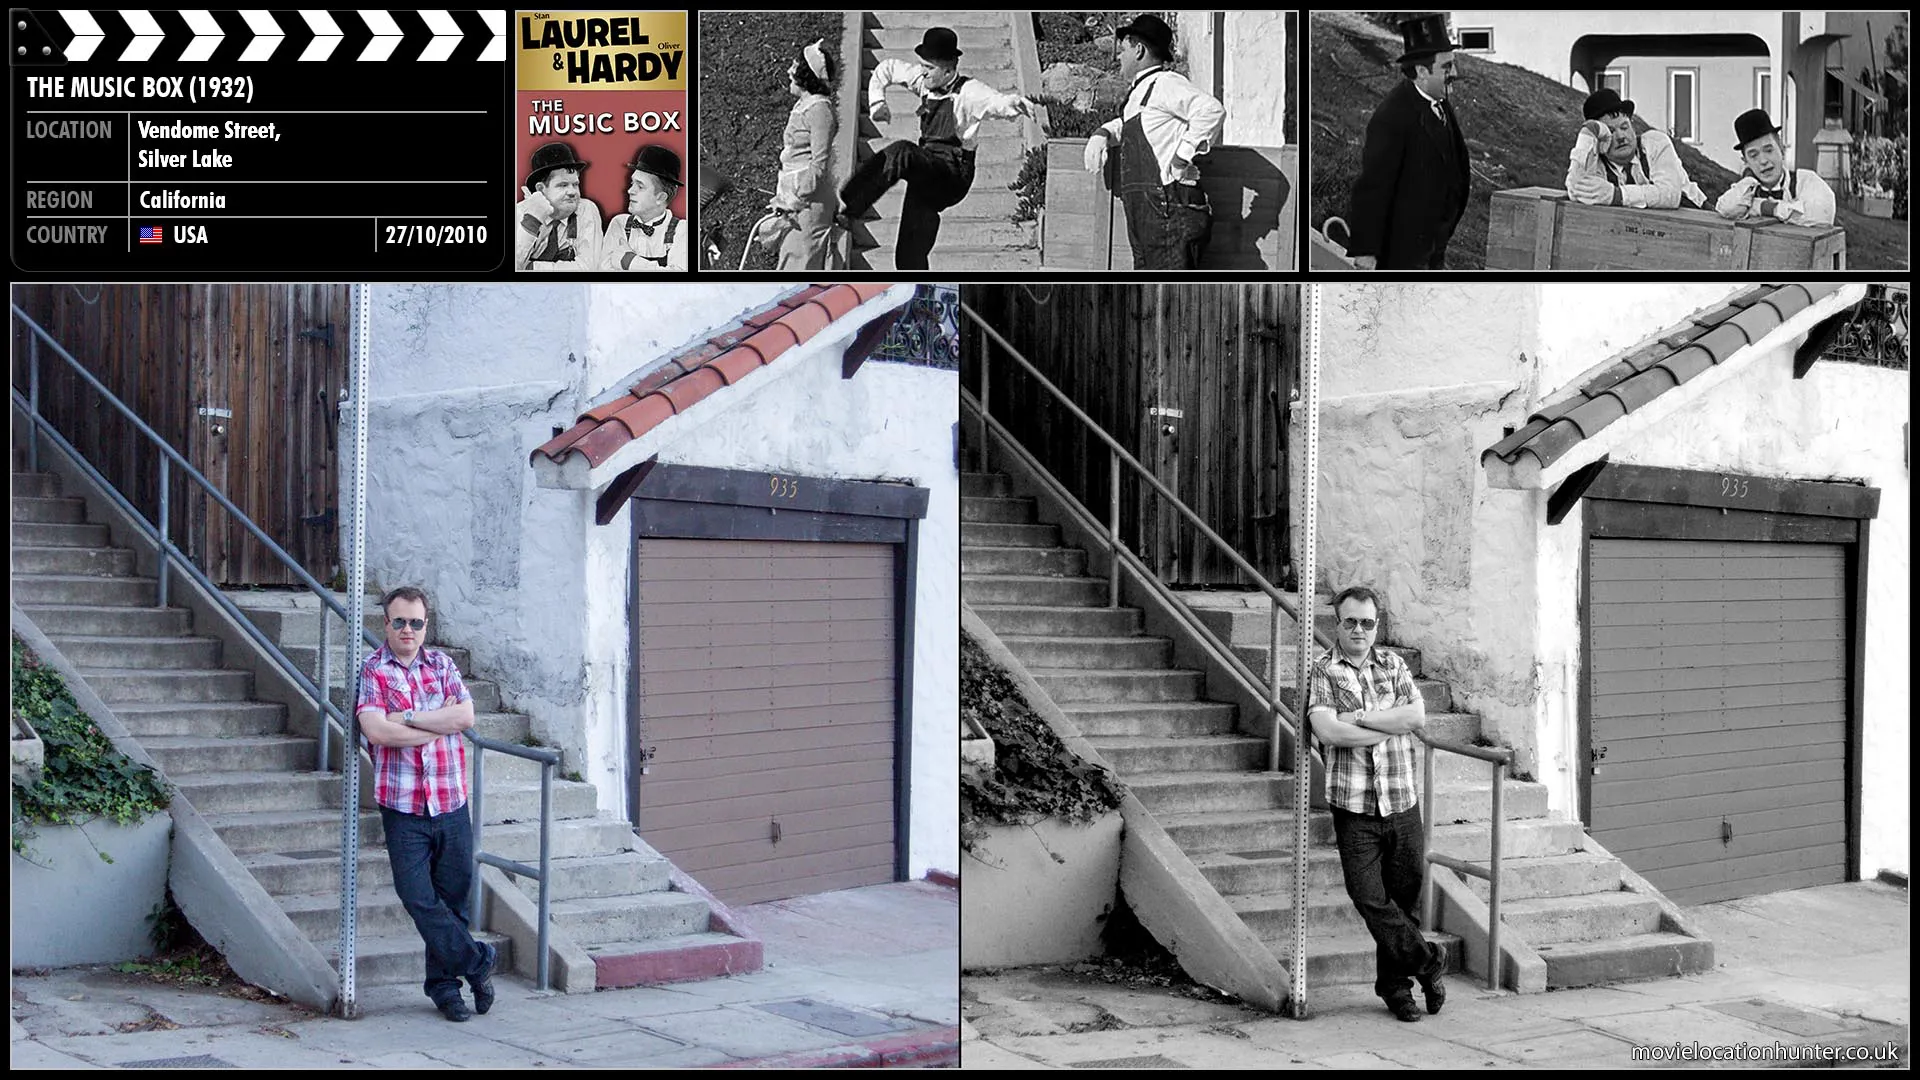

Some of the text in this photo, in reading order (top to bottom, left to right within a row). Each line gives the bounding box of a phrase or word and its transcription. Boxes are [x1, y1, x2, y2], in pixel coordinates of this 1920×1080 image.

[534, 12, 550, 20] Stan
[522, 17, 649, 49] LAUREL
[657, 42, 680, 50] Oliver
[552, 50, 684, 84] & HARDY
[532, 100, 563, 113] THE
[528, 111, 681, 136] MUSIC BOX
[770, 477, 798, 498] 935
[1721, 477, 1749, 498] 935
